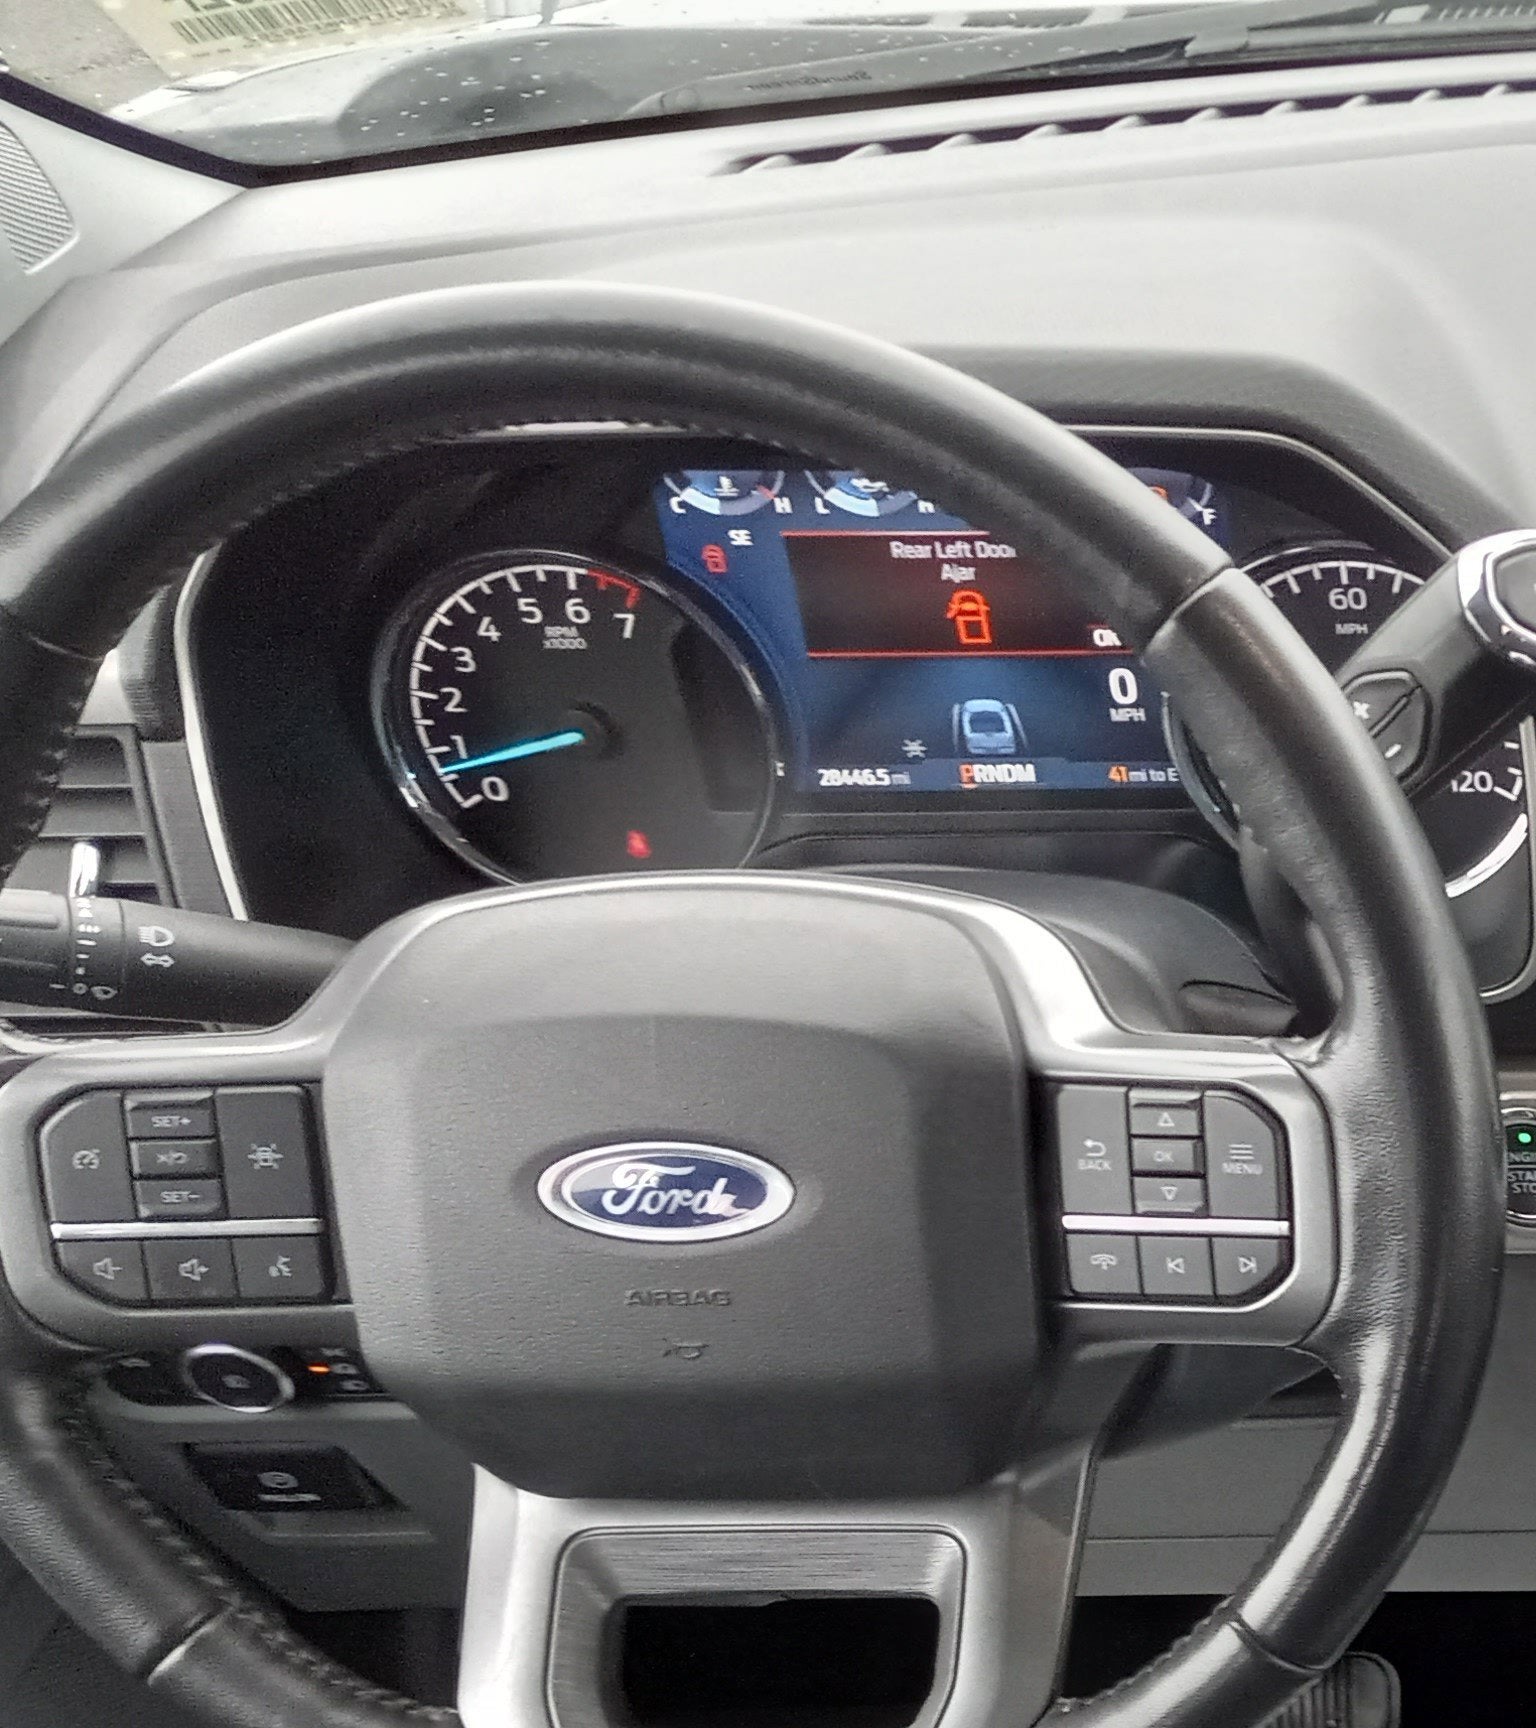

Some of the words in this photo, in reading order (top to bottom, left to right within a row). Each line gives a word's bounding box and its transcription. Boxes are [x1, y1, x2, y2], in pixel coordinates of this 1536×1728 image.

[773, 497, 794, 514] H
[815, 496, 831, 515] L
[889, 541, 933, 559] Rear
[934, 540, 974, 559] Left
[941, 564, 977, 583] Ajar
[565, 597, 591, 624] 6
[1328, 588, 1368, 612] 60
[516, 597, 543, 625] 5
[476, 616, 502, 642] 4
[612, 612, 636, 639] 7
[1335, 622, 1369, 636] MPH
[450, 646, 477, 673] 3
[1107, 667, 1139, 705] 0
[439, 686, 468, 713] 2
[1109, 707, 1147, 723] MPH
[449, 734, 469, 760] 1
[1107, 765, 1129, 782] 41
[1149, 766, 1166, 783] to
[480, 776, 510, 801] 0
[1077, 1159, 1112, 1172] BACK
[1153, 1151, 1175, 1163] OK
[1221, 1162, 1264, 1175] MENU
[600, 1161, 753, 1218] Ford
[624, 1288, 732, 1307] AIRBAG
